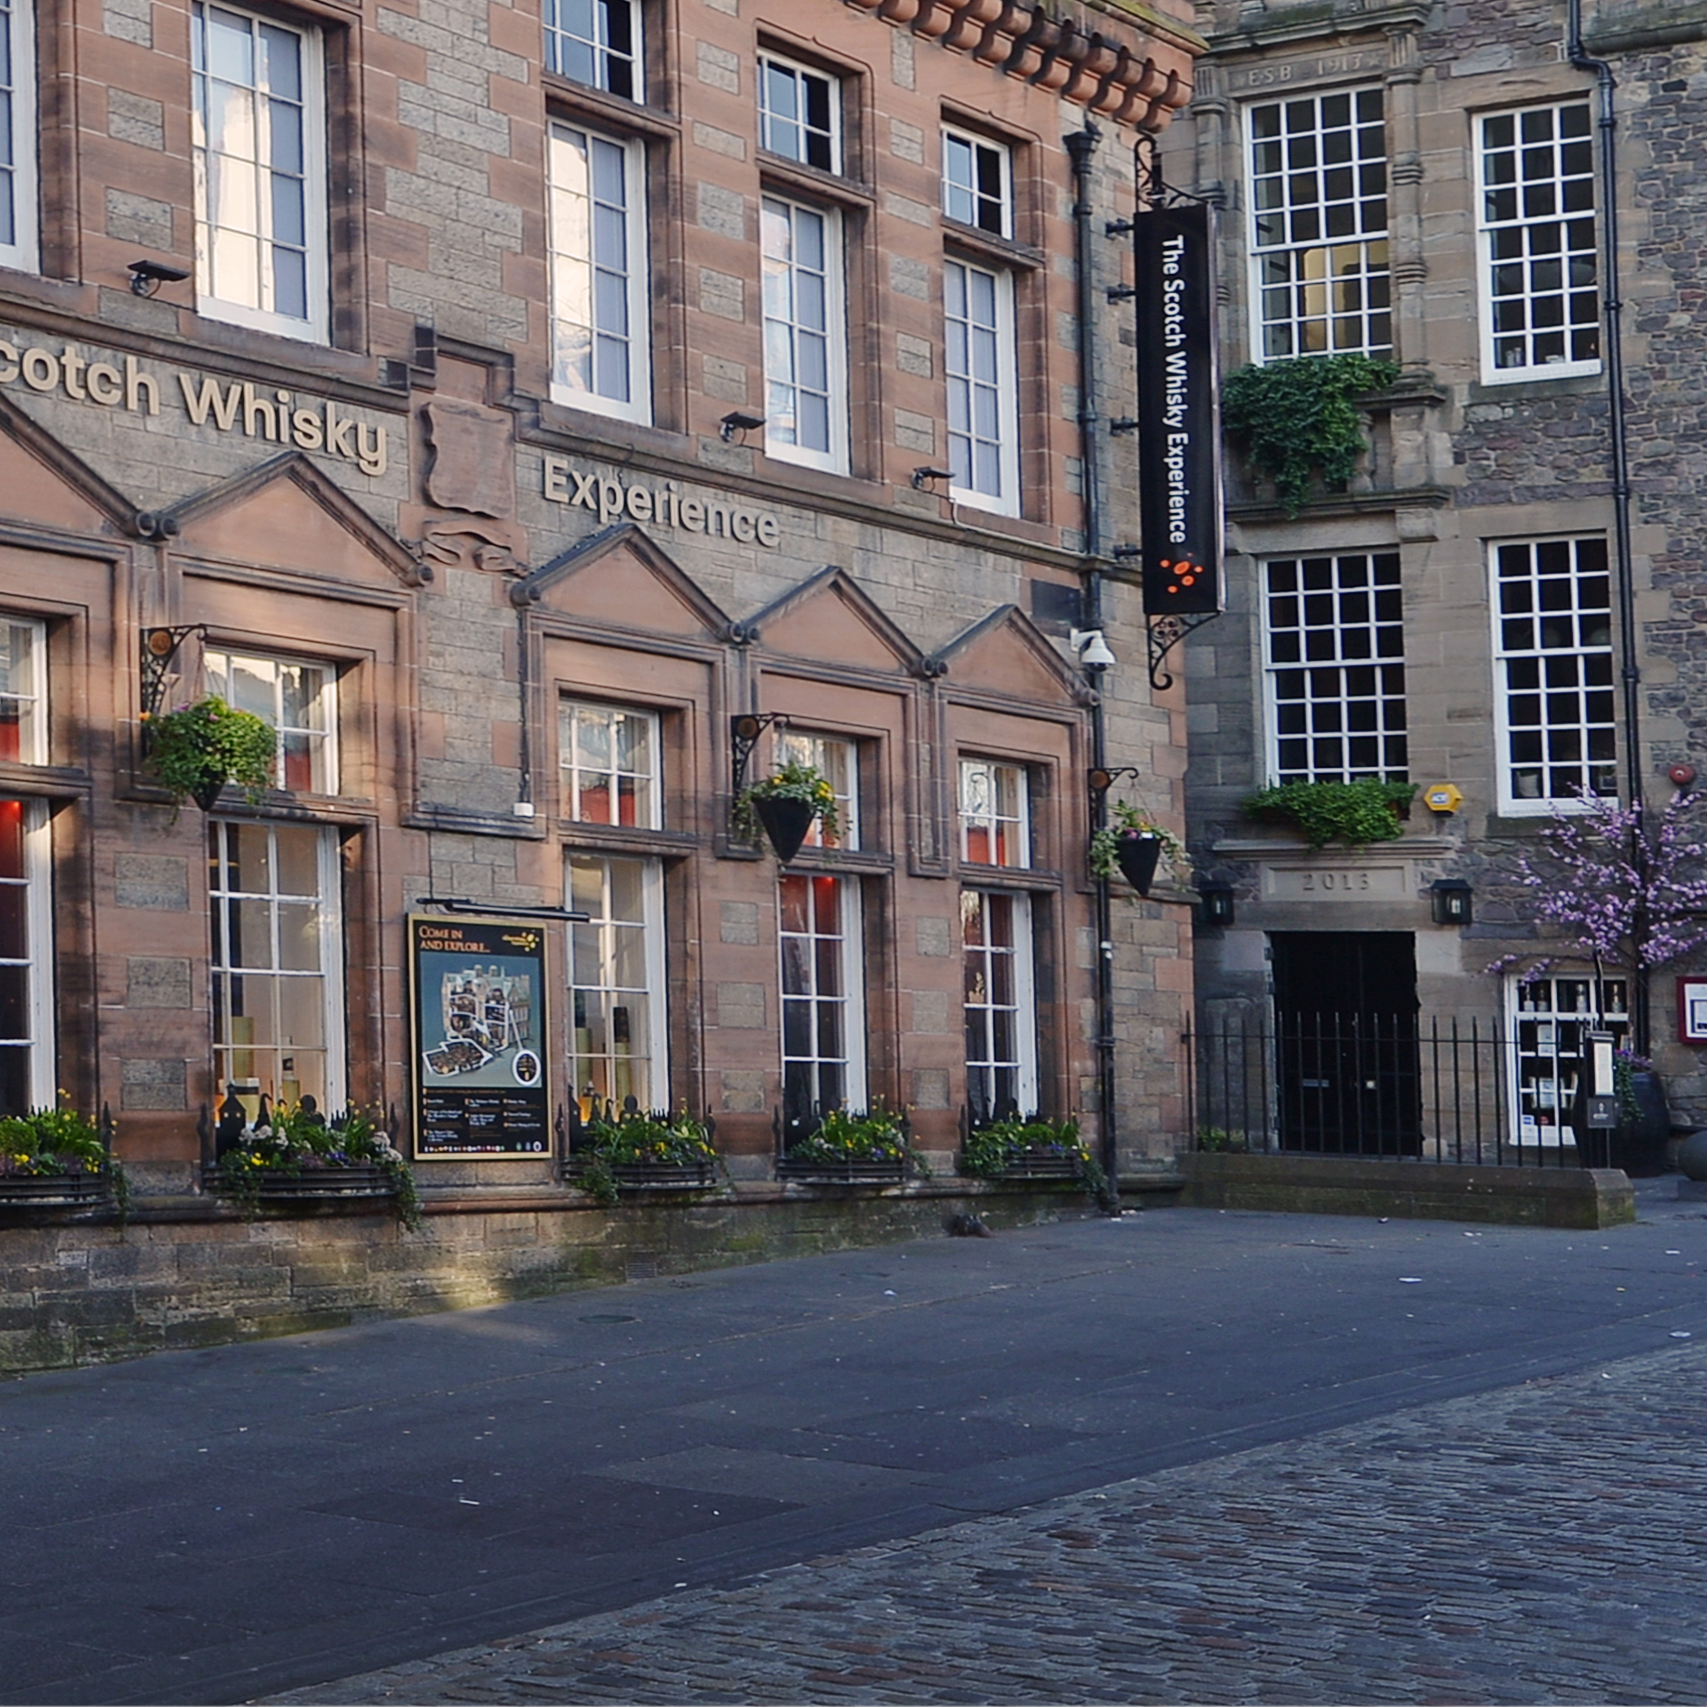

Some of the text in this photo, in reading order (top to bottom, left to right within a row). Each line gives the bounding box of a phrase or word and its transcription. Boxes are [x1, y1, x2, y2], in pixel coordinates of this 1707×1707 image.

[1162, 234, 1190, 544] The Scotch Whisky Experience
[178, 372, 387, 476] Whisky
[543, 455, 781, 547] Experience
[1302, 874, 1369, 891] 2013
[420, 940, 443, 950] AND
